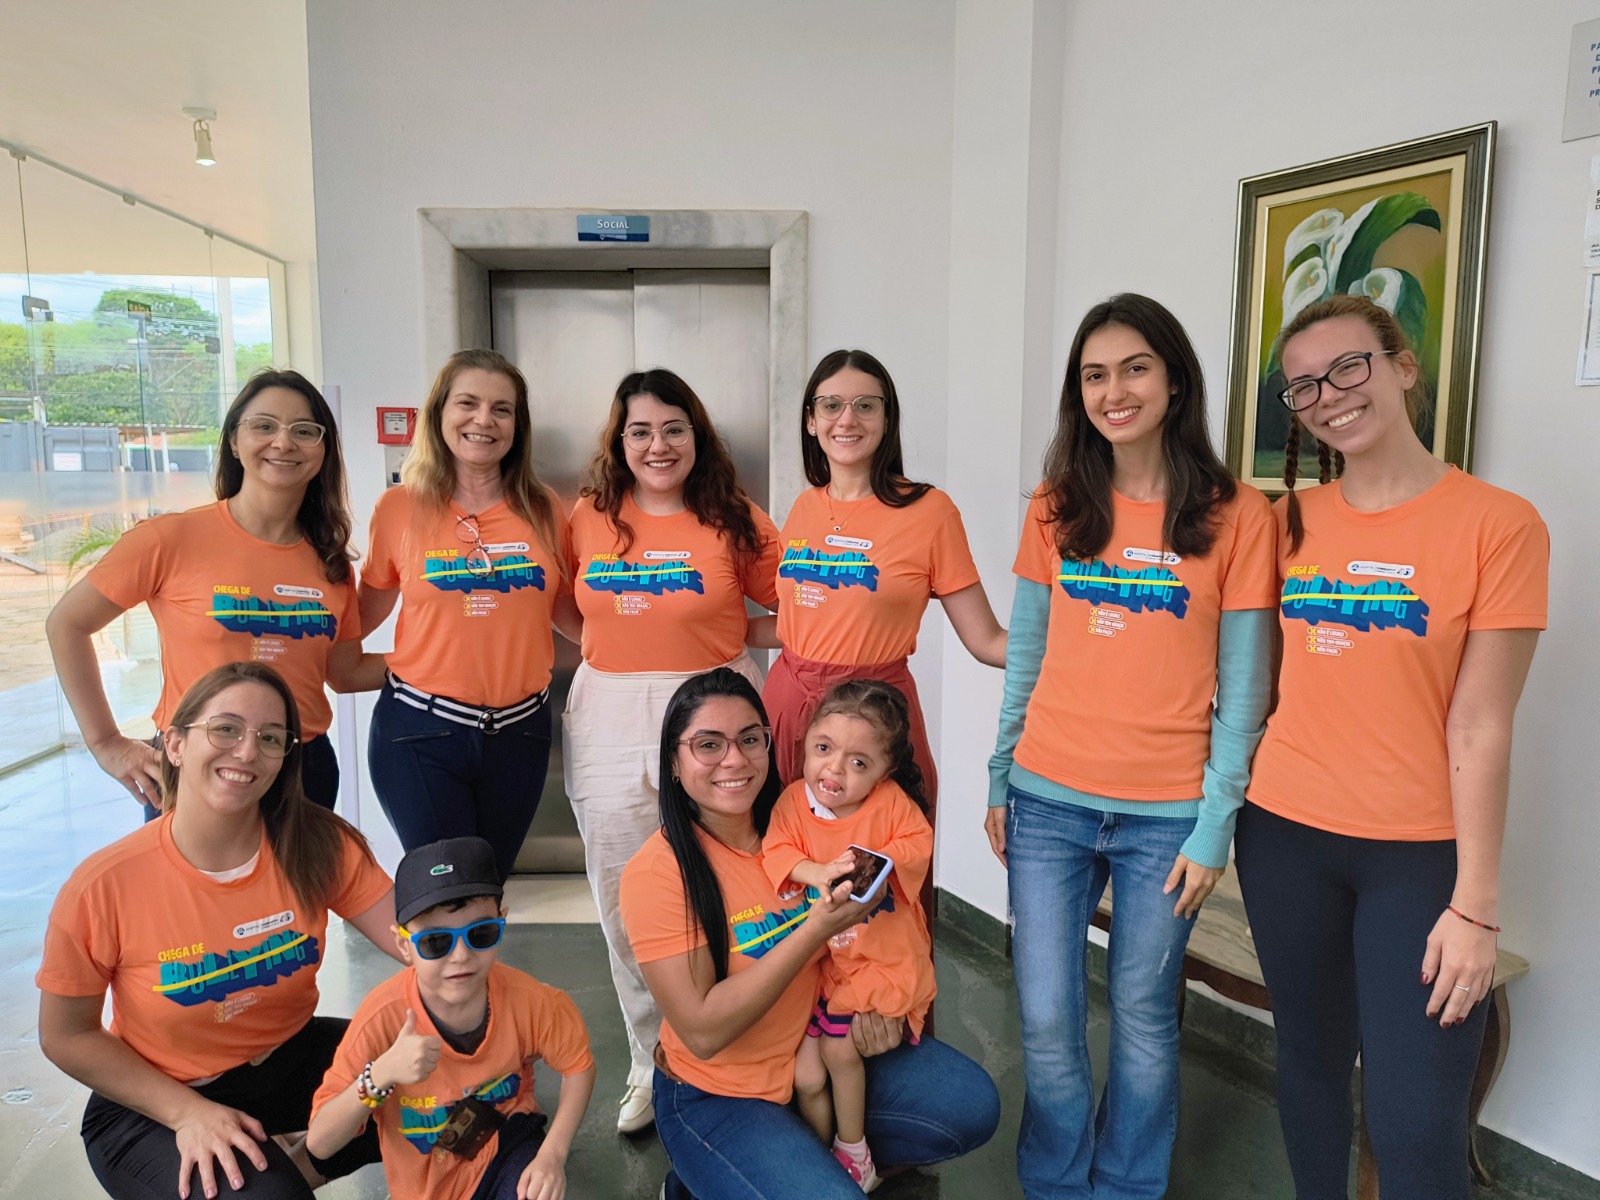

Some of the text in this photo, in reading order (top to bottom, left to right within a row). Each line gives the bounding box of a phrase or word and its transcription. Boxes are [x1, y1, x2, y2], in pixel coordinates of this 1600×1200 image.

[597, 219, 630, 229] SOCIAL
[584, 560, 690, 586] BULLYING
[1307, 564, 1320, 575] DE
[213, 584, 252, 595] CHEGA DE
[1281, 575, 1414, 622] BULLYING
[212, 594, 330, 631] BULLYING
[754, 904, 764, 916] DE
[158, 943, 205, 962] CHEGA DE
[160, 929, 308, 996] BULLYING
